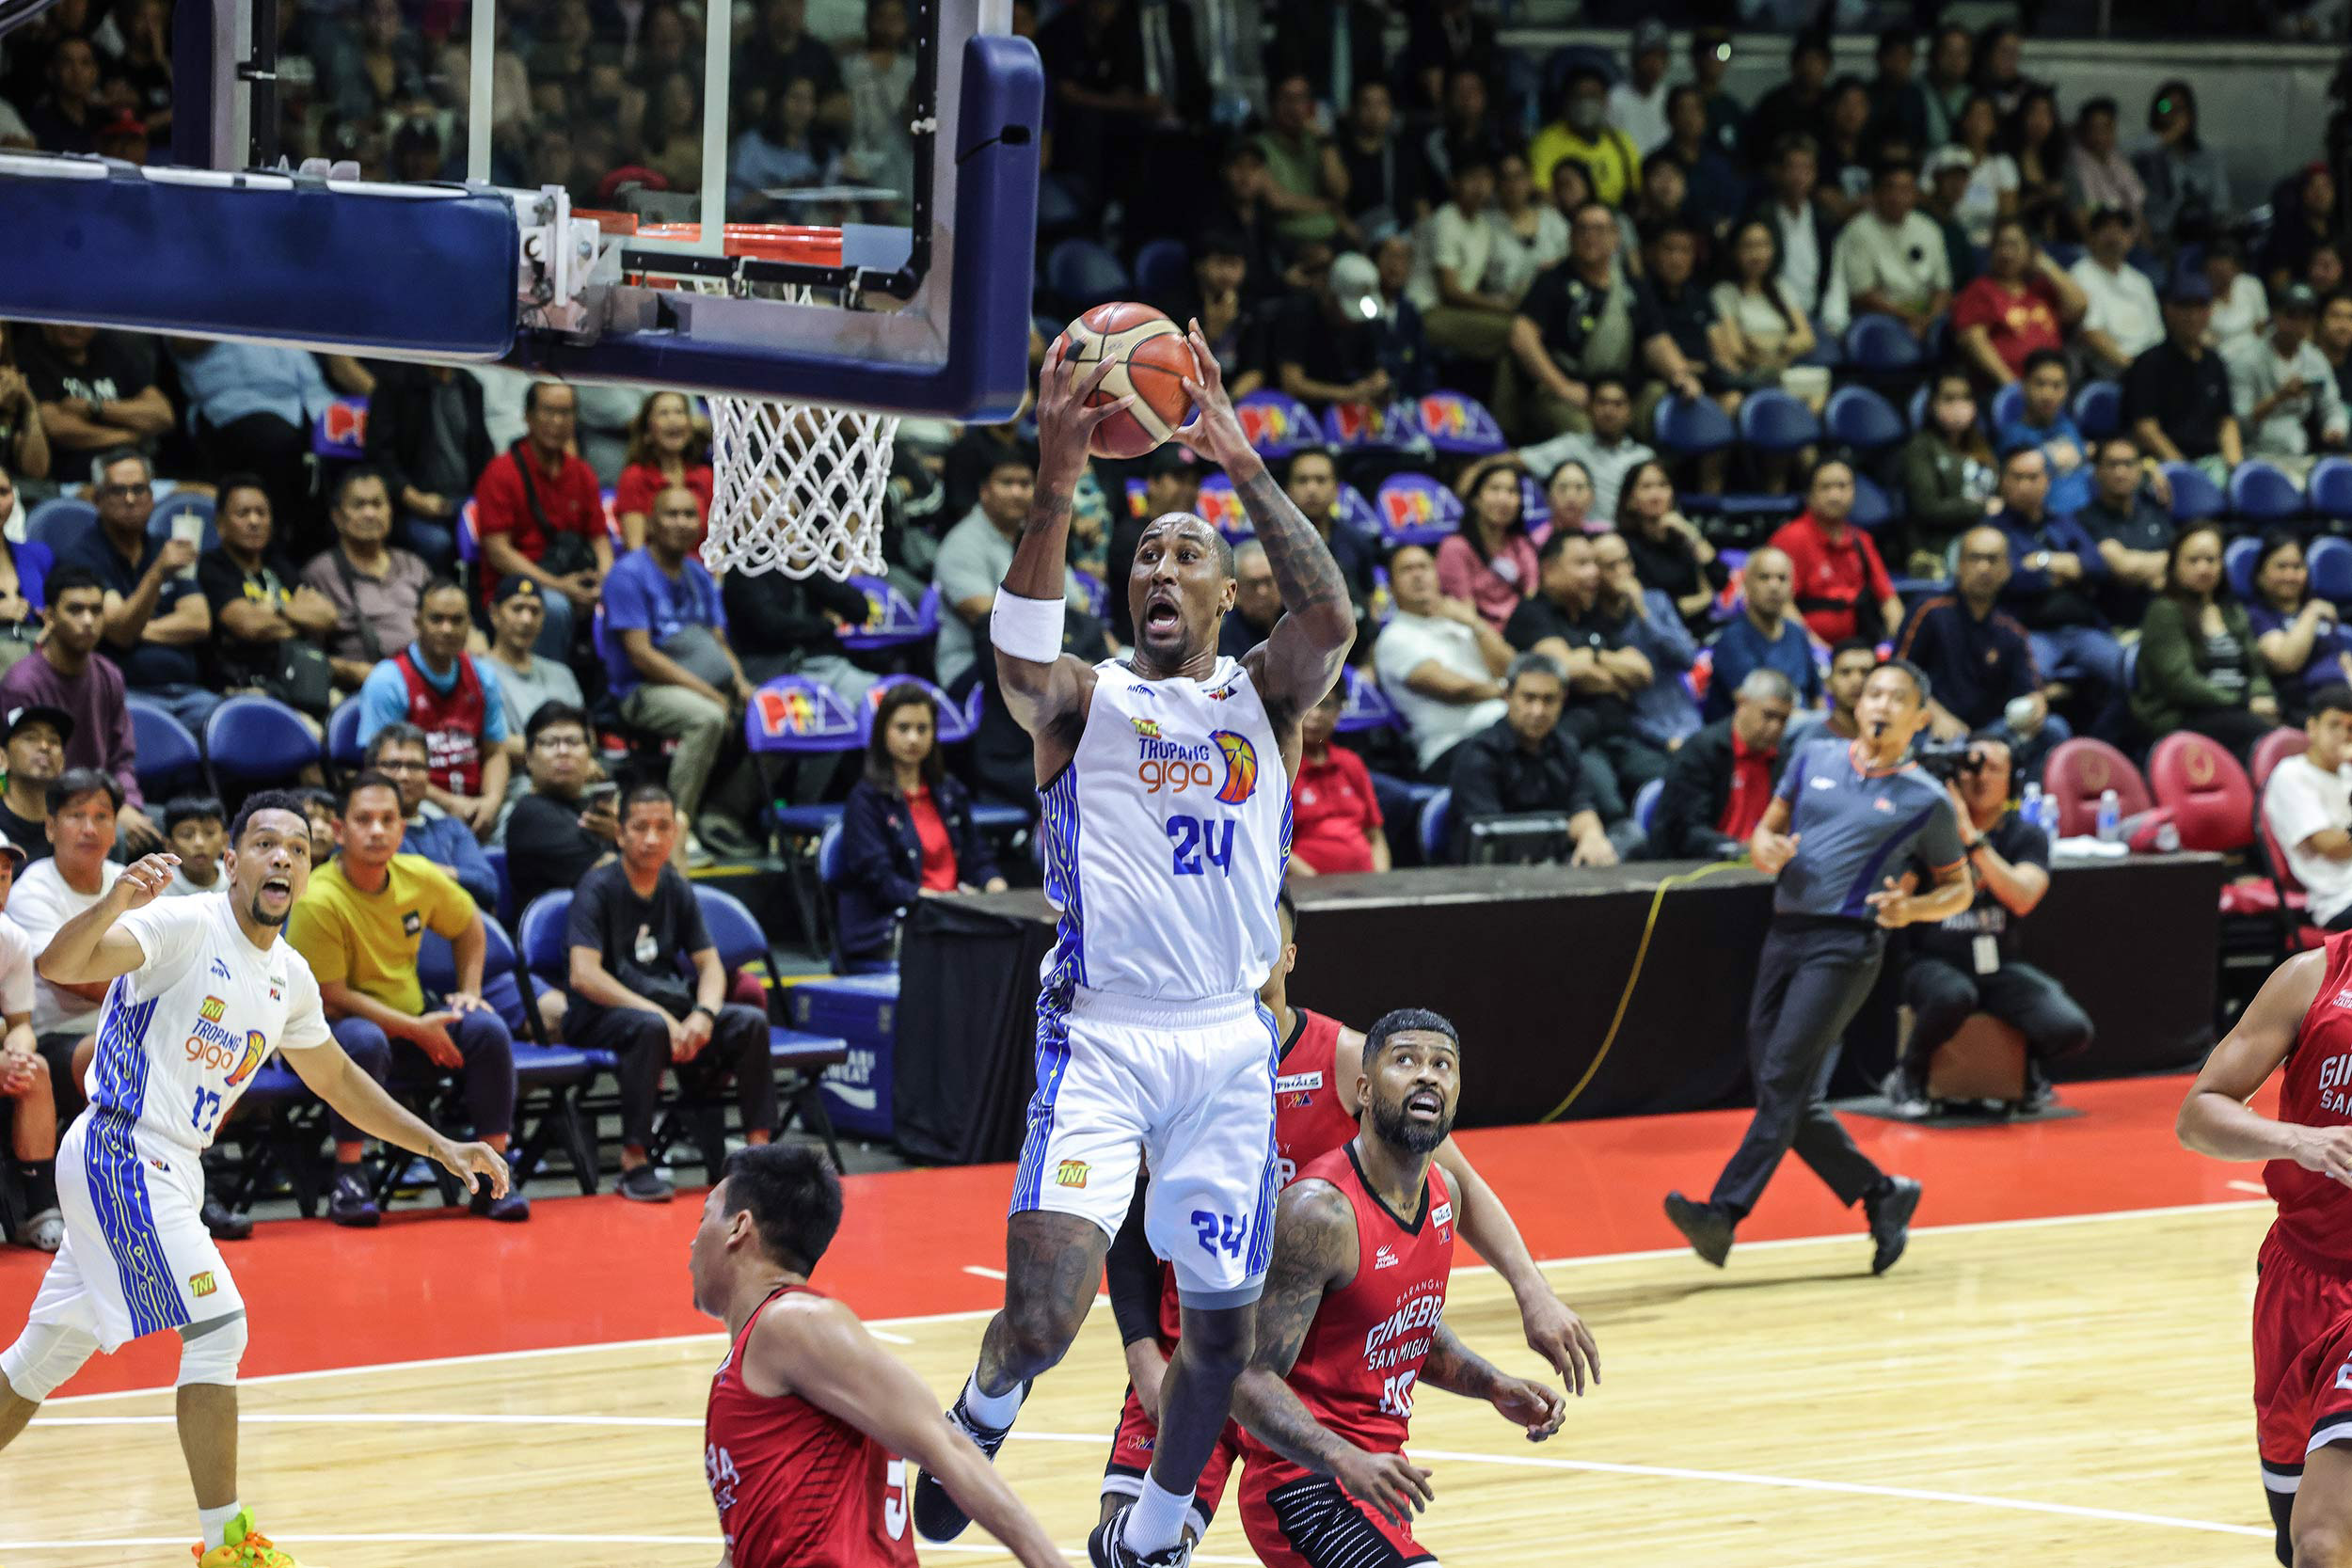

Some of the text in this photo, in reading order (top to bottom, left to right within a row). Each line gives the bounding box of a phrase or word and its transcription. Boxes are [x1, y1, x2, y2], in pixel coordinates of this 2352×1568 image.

[1138, 737, 1210, 761] TROPANG
[1138, 760, 1213, 794] giga
[1167, 816, 1235, 878] 24
[199, 997, 226, 1021] TNT
[192, 1018, 242, 1053] TROPANG
[185, 1036, 234, 1069] giga
[191, 1085, 222, 1132] 17
[1056, 1164, 1091, 1184] TNT
[1190, 1210, 1248, 1259] 24
[189, 1270, 215, 1299] TNT
[1395, 1278, 1445, 1307] BARANGAY
[1367, 1346, 1399, 1371] SAN
